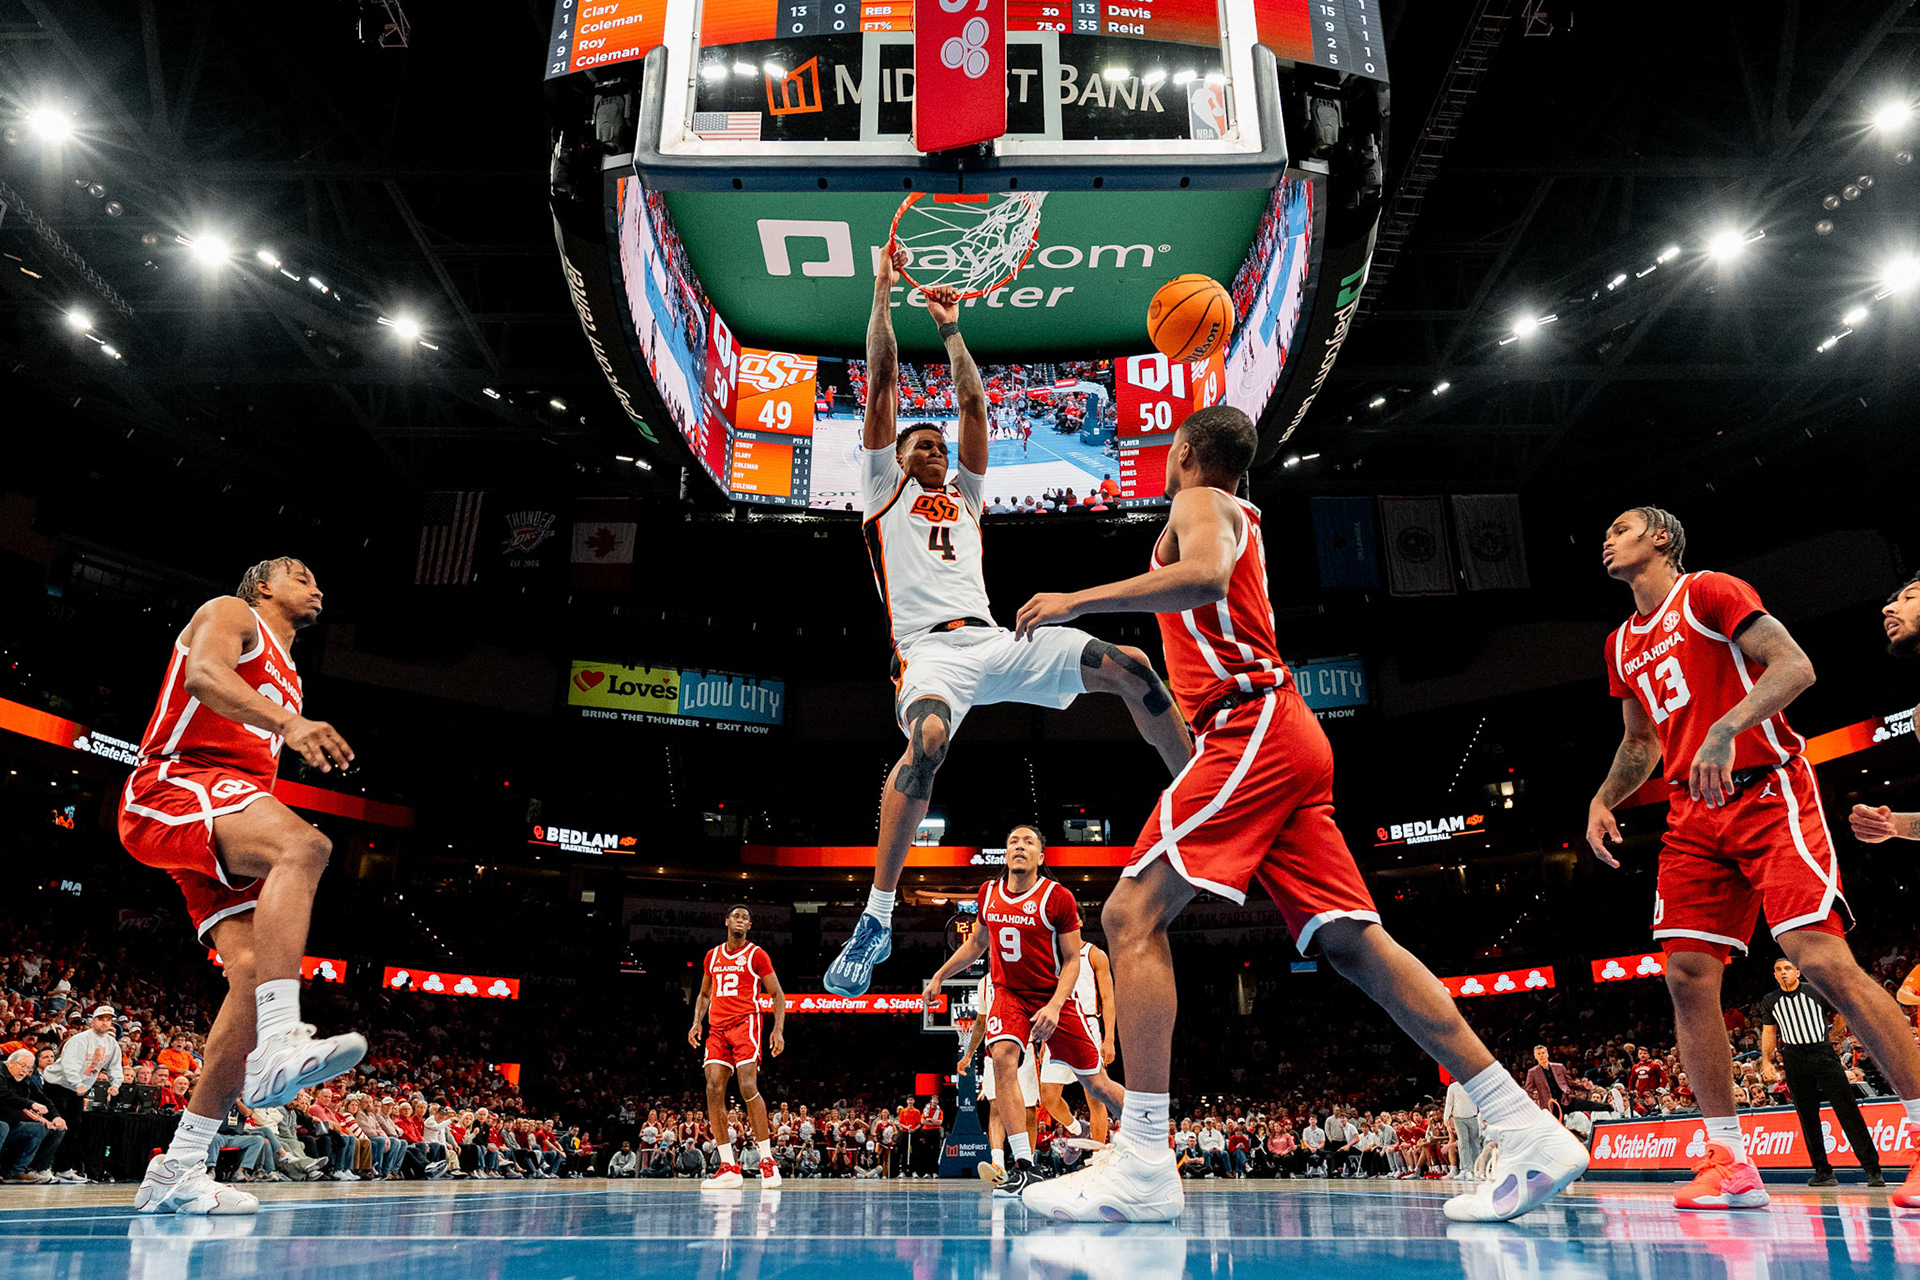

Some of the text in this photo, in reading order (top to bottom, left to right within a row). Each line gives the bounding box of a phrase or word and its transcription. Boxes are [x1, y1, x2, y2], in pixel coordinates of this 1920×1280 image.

[562, 3, 619, 24] 1 Clary
[790, 3, 846, 17] 13 0
[865, 6, 1060, 16] REB 30
[1078, 3, 1152, 19] 13 Davis
[1320, 5, 1367, 25] 15 1
[558, 14, 643, 40] 4 Coleman
[792, 20, 845, 33] 0 0
[864, 22, 1066, 32] FT% 75.0
[1078, 20, 1145, 36] 35 Reid
[1325, 22, 1369, 41] 9 1
[556, 37, 606, 57] 9 Roy
[1327, 38, 1371, 57] 2 1
[551, 47, 640, 74] 21 Coleman
[1329, 54, 1375, 73] 5 0
[1058, 64, 1165, 113] BANK
[1196, 129, 1215, 140] NBA
[713, 368, 729, 410] 50
[758, 399, 792, 430] 49
[1140, 400, 1172, 432] 50
[736, 431, 757, 440] PLAYER
[910, 494, 959, 524] OSU
[504, 510, 556, 530] THUNDER
[928, 525, 957, 561] 4
[1623, 631, 1685, 675] OKLAHOMA
[1318, 668, 1362, 699] CITY
[1636, 655, 1691, 725] 13
[684, 681, 780, 718] LOUD CITY
[582, 709, 769, 734] BRING THE THUNDER EXIT NOW
[1327, 708, 1355, 719] NOW
[91, 730, 140, 752] PRESENTED BY
[546, 826, 619, 849] BEDLAM
[1390, 815, 1465, 840] BEDLAM
[1406, 832, 1452, 845] BASKETBALL
[560, 843, 603, 855] BASKETBALL
[987, 912, 1036, 926] OKLAHOMA
[999, 926, 1022, 962] 9
[713, 965, 744, 973] OKLAHOMA
[715, 973, 739, 997] 12
[816, 998, 866, 1009] StateFarm
[1611, 1132, 1677, 1159] StateFarm
